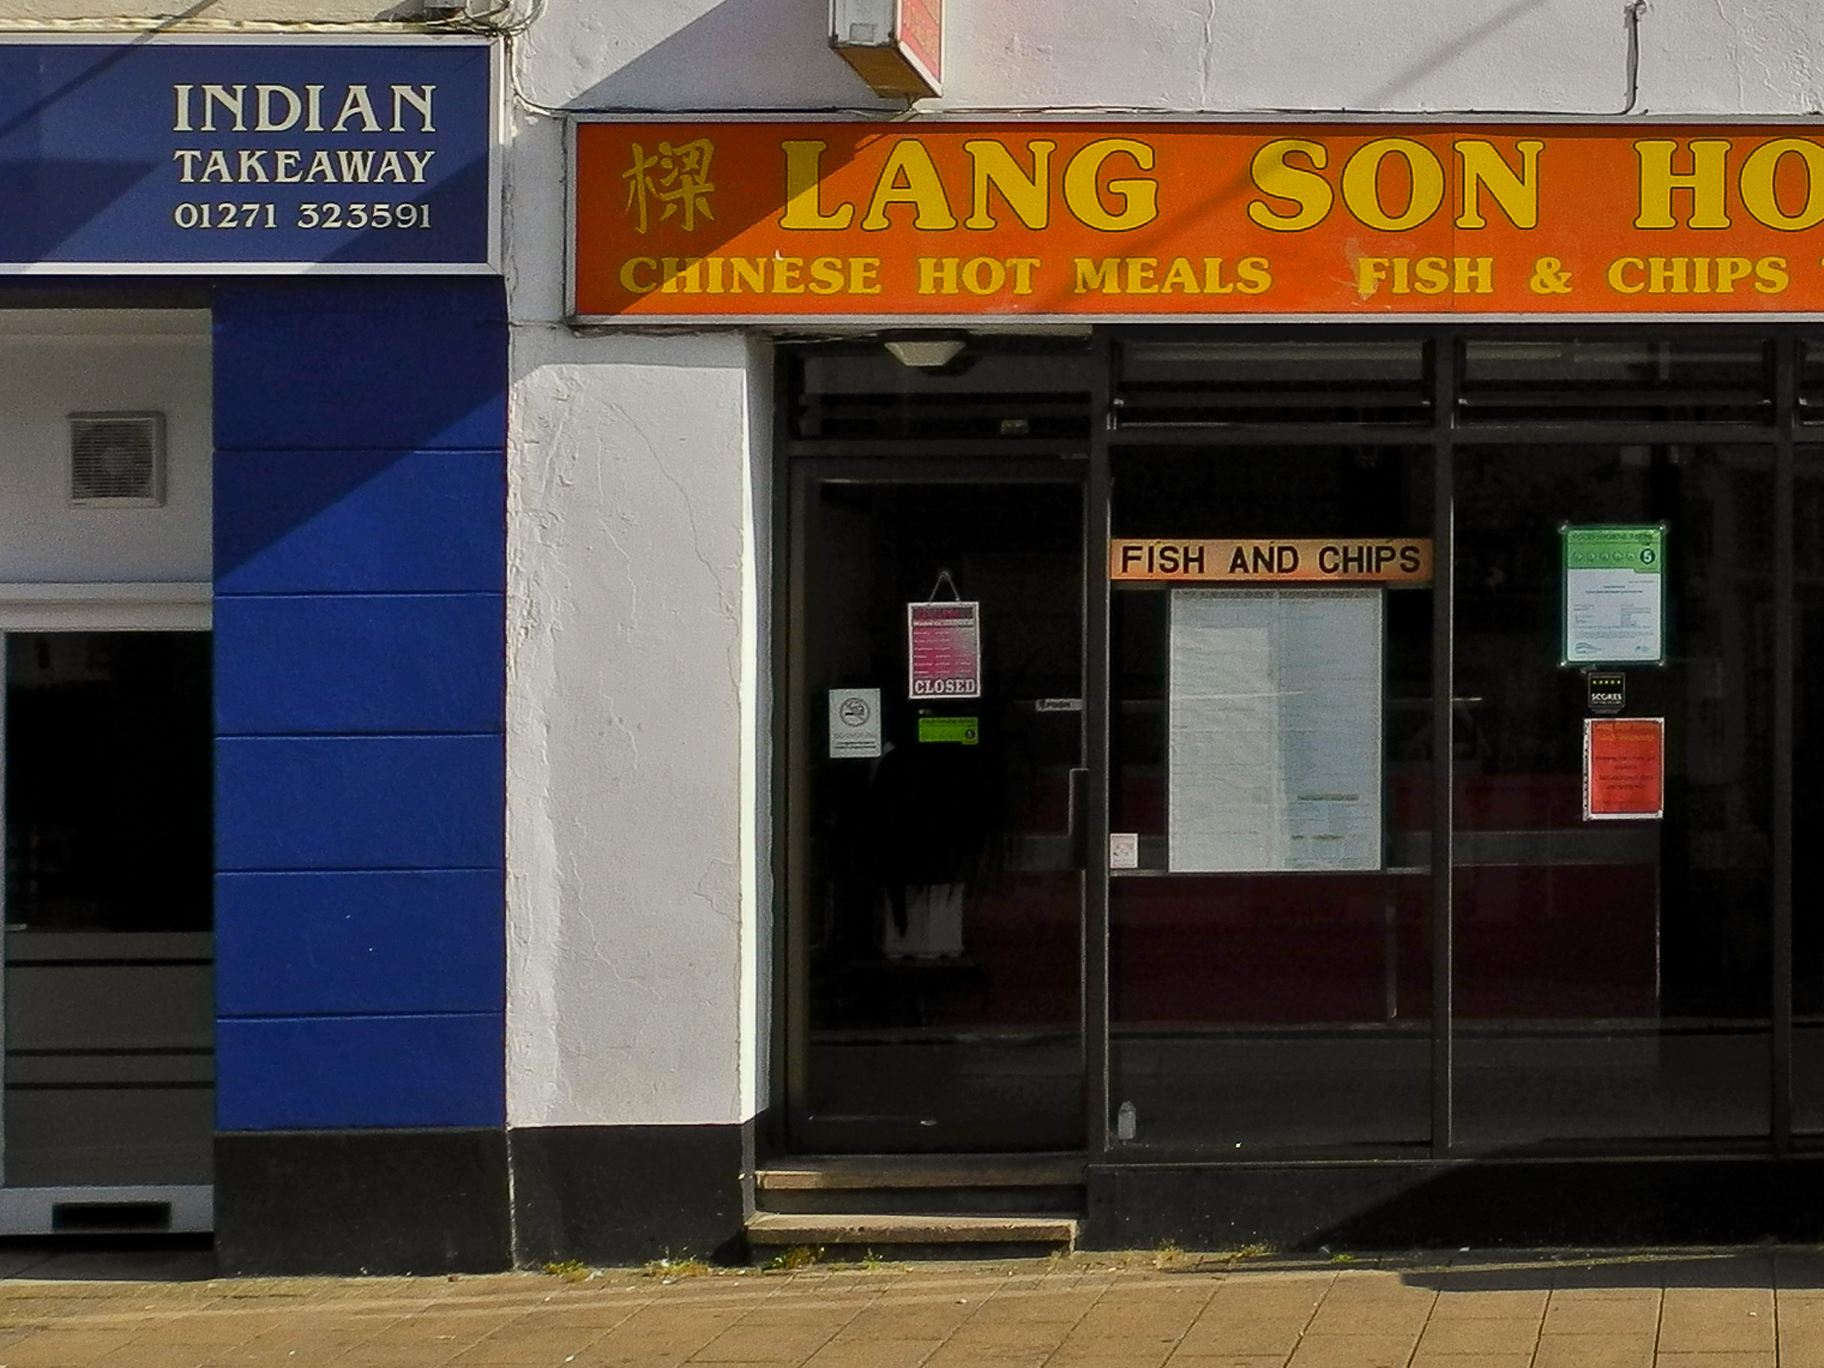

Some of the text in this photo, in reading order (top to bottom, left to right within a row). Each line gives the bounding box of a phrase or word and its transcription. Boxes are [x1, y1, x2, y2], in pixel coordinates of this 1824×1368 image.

[174, 84, 437, 132] INDIAN
[174, 150, 436, 183] TAKEAWAY
[778, 137, 1160, 232] LANG
[1247, 137, 1544, 232] SON
[174, 203, 432, 229] 01271 323591
[619, 255, 1272, 295] CHINESE HOT MEALS
[1357, 255, 1494, 295] FISH
[1529, 255, 1573, 295] &
[1607, 255, 1789, 295] CHIPS
[1121, 545, 1421, 574] FISH AND CHIPS
[1642, 550, 1652, 563] 5
[914, 679, 975, 694] CLOSED
